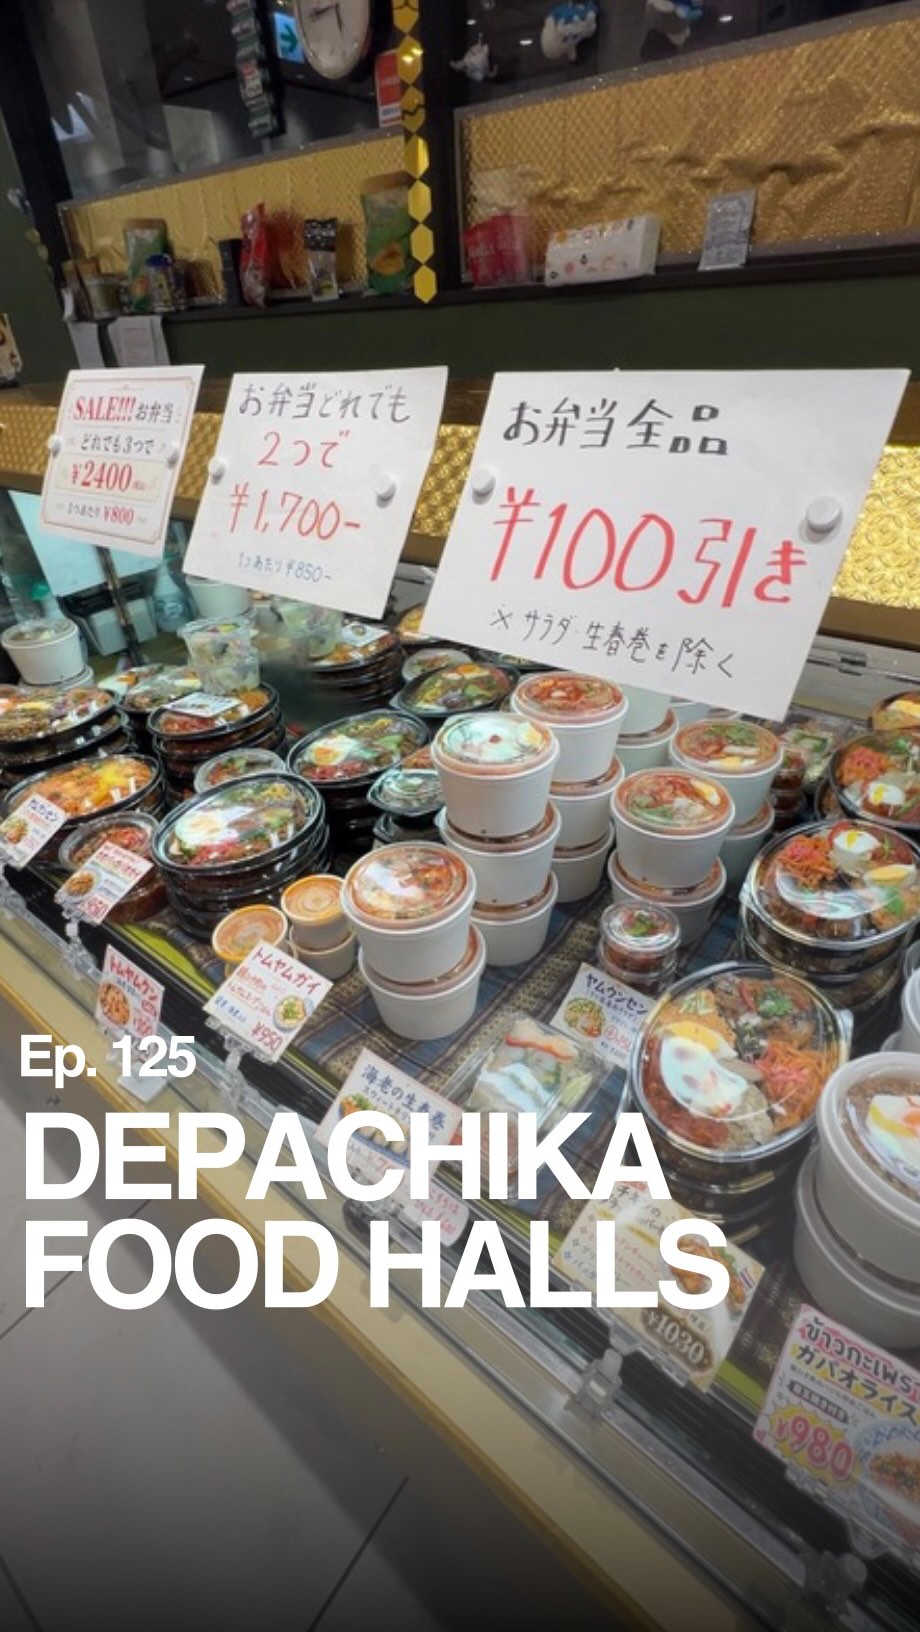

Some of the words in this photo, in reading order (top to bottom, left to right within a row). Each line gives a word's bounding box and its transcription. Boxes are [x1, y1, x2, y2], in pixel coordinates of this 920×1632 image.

[73, 395, 137, 422] SALE!!!
[135, 401, 174, 423] お弁当
[239, 382, 410, 423] お弁当どれでも
[81, 434, 155, 455] どれでも3つで
[258, 430, 350, 468] 2つで
[502, 396, 729, 456] お弁当全品
[71, 460, 133, 492] ¥2400
[103, 506, 134, 526] ¥800
[489, 486, 808, 609] ¥100引き
[252, 947, 321, 996] トムヤムガイ
[586, 973, 649, 1016] ヤムウンセン
[649, 1309, 706, 1365] ¥1030
[805, 1316, 920, 1397] ข้าวกะเพร
[797, 1344, 918, 1427] ガパオライス
[774, 1415, 854, 1482] ¥980
